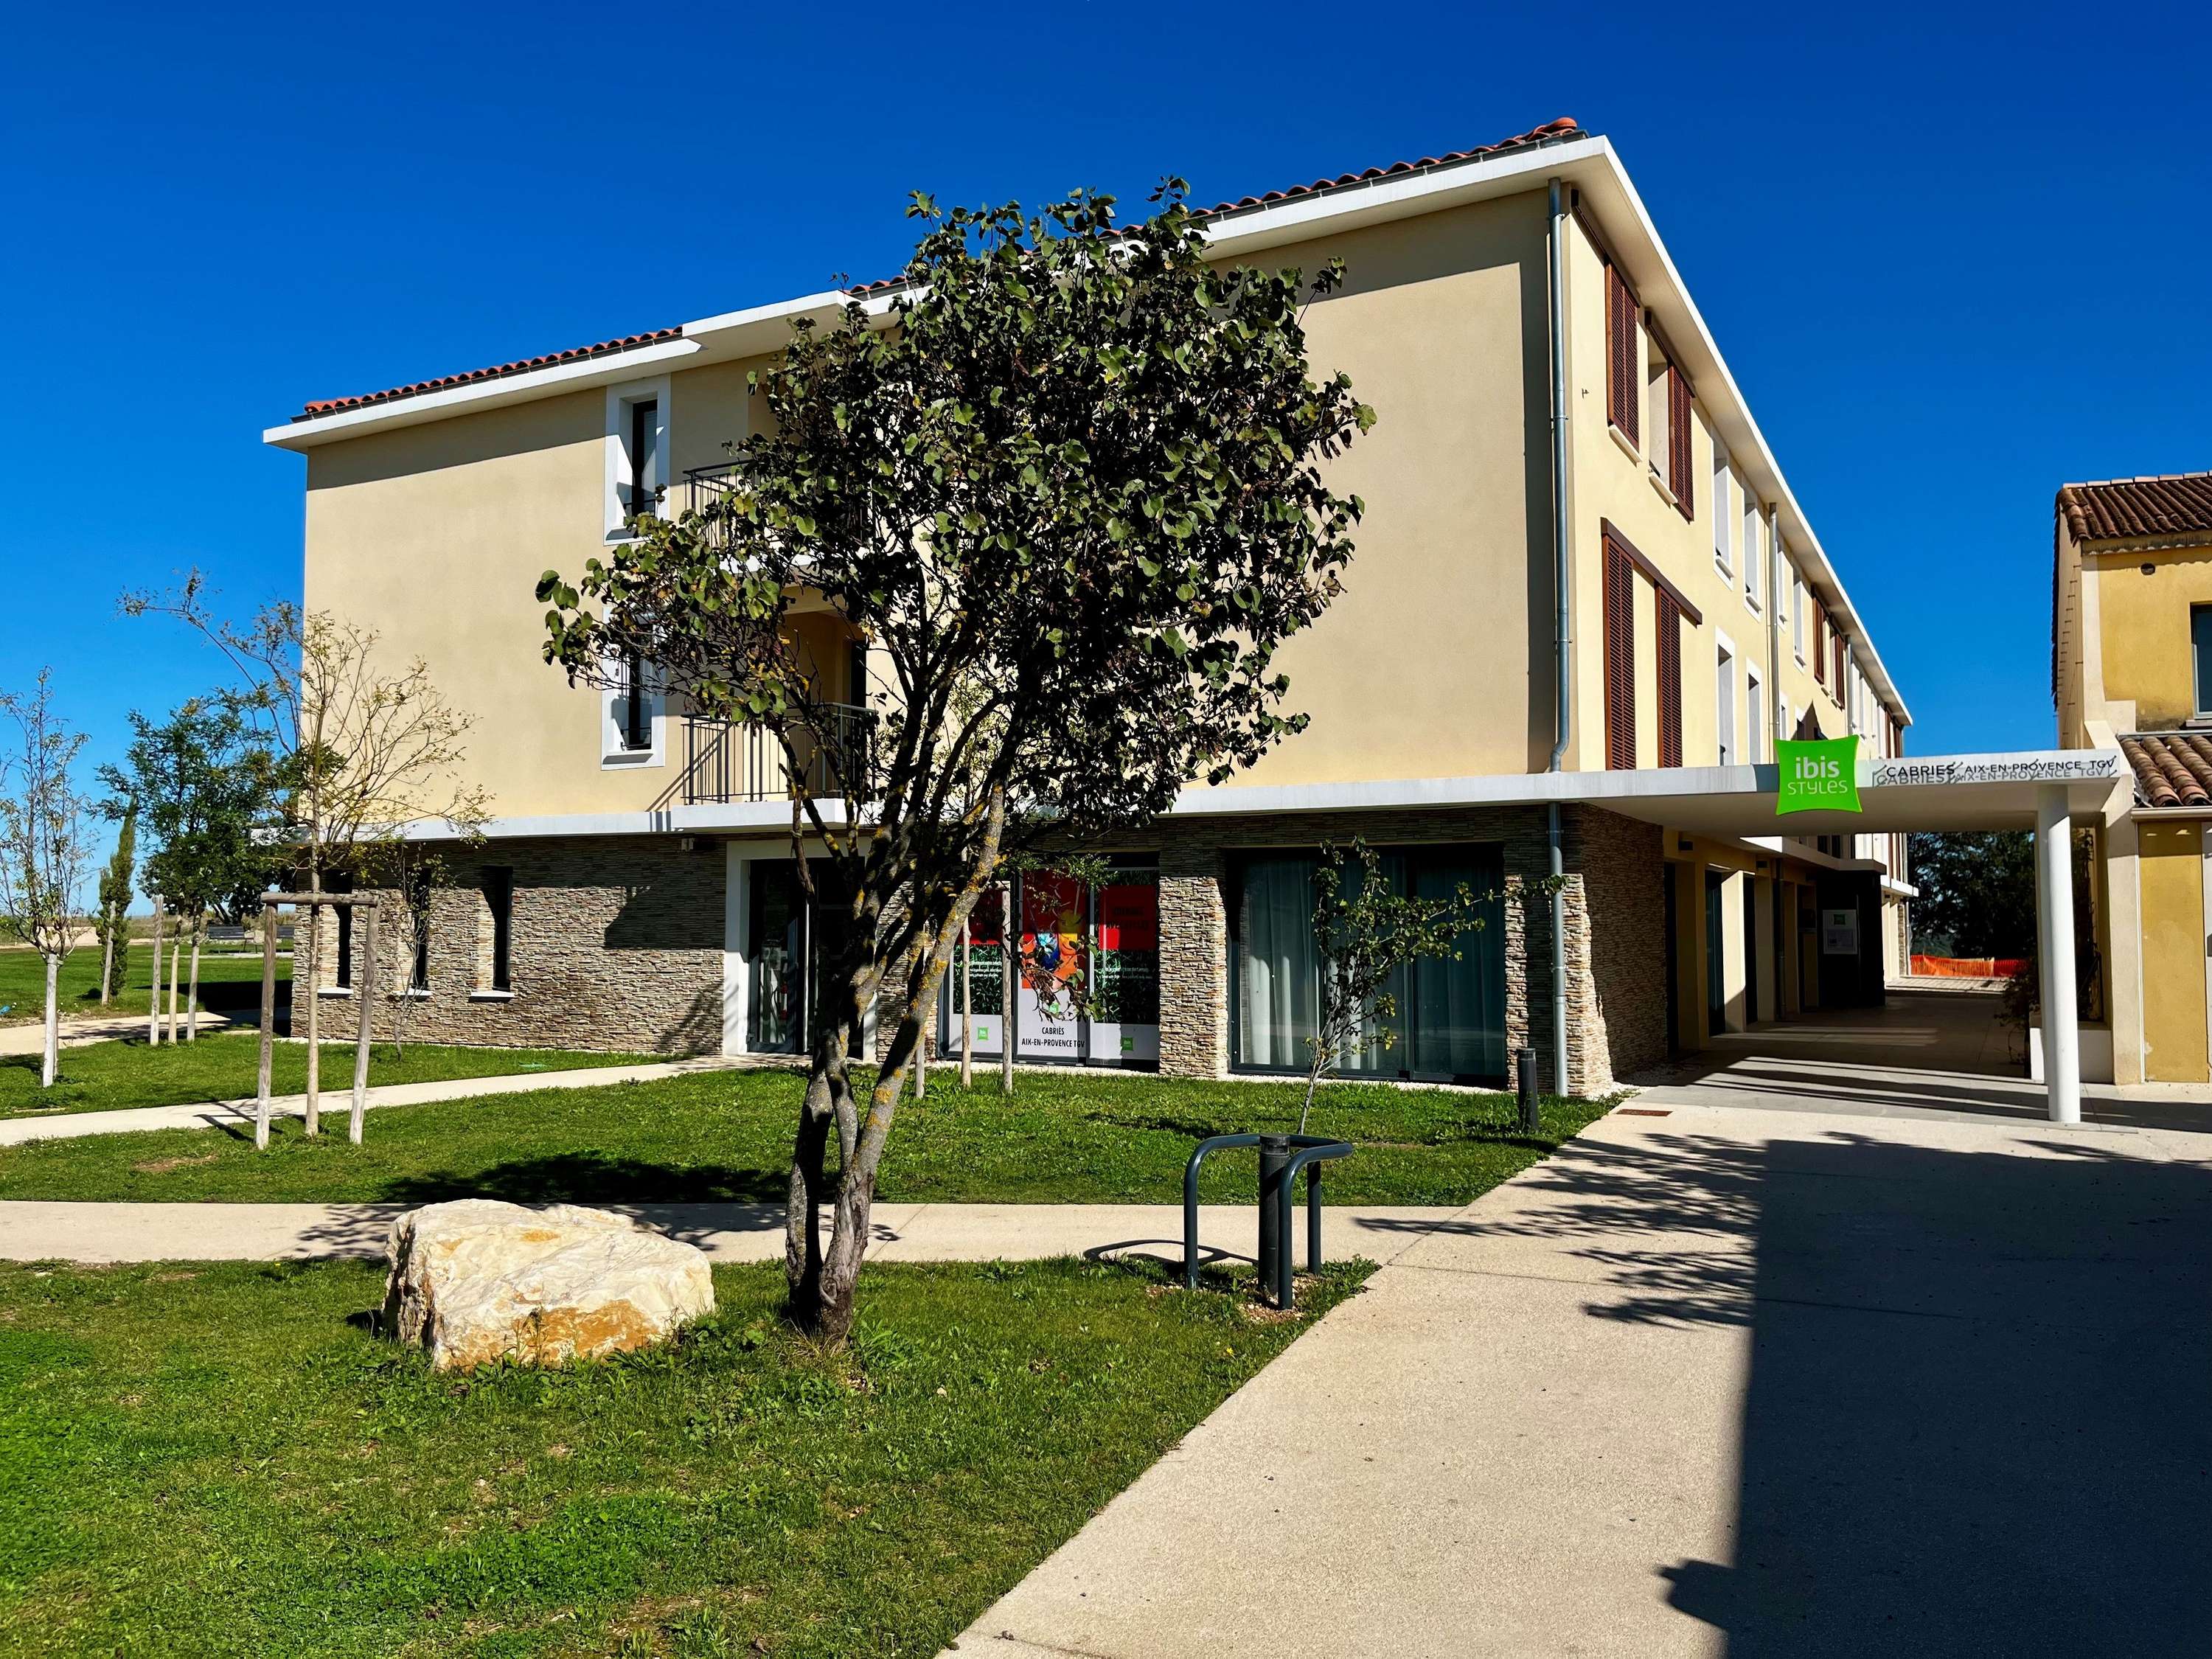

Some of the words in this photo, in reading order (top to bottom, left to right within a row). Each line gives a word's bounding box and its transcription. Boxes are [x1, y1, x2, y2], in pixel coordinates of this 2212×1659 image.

[1795, 755, 1840, 779] ibis
[1886, 764, 1955, 777] CABRIES
[1964, 761, 2081, 773] AIX-EN-PROVENCE
[2089, 759, 2115, 770] TGV
[1022, 1038, 1072, 1047] AIX-EN-PROVENCE
